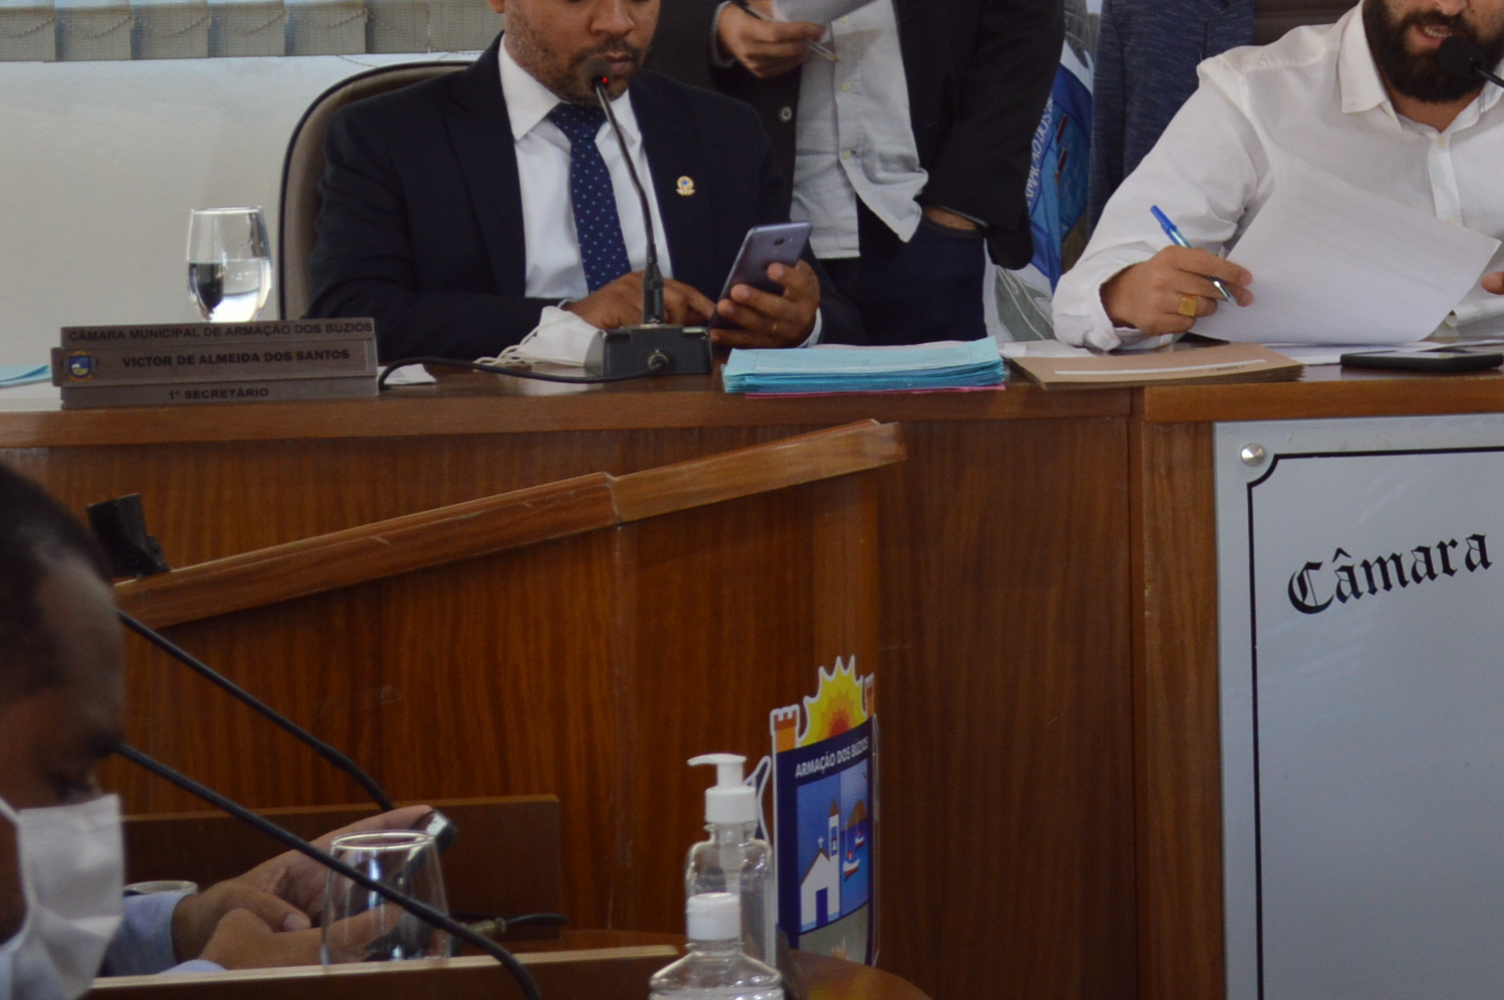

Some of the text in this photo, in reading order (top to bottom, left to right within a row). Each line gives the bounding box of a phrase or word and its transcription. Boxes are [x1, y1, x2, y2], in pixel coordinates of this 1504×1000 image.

[129, 327, 199, 340] MUNICIPAL
[204, 326, 221, 337] DE
[295, 323, 322, 334] DOS
[123, 349, 350, 367] VICTOR DE ALMEIDA DOS SANTOS
[1287, 532, 1493, 615] Câmara
[795, 750, 836, 779] ARMAÇÃO
